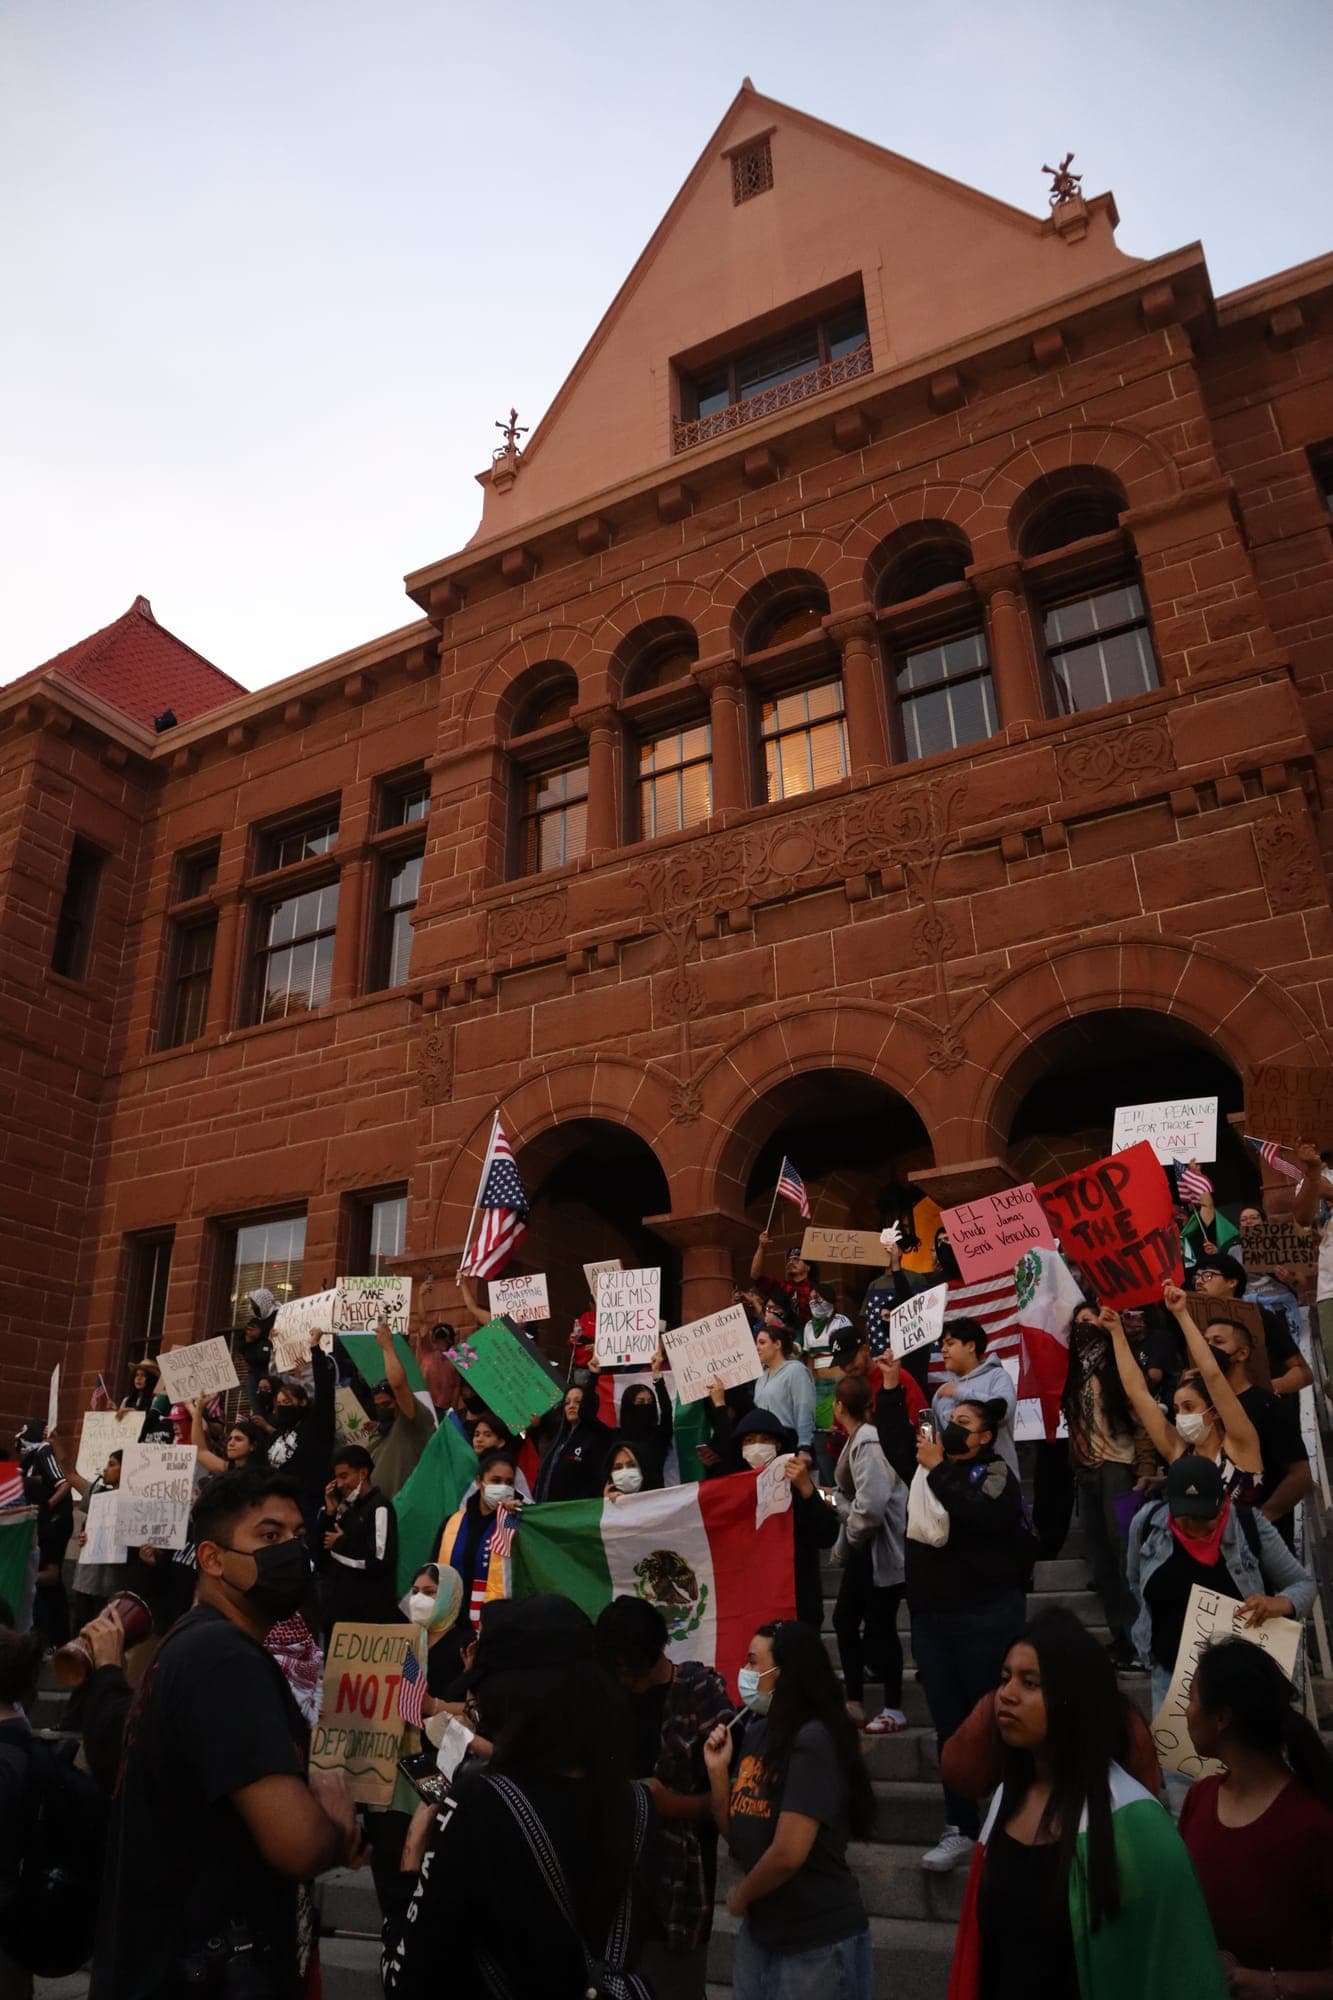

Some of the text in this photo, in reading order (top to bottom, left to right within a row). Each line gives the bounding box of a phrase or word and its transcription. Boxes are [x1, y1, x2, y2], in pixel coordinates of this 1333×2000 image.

[1151, 1103, 1217, 1119] PEAKING
[990, 1191, 1034, 1212] Pueblo
[1040, 1162, 1129, 1229] STOP
[811, 1231, 859, 1244] FUCK
[1072, 1210, 1139, 1251] THE
[827, 1246, 865, 1260] ICE
[1241, 1236, 1313, 1251] DEPORTING
[1243, 1250, 1314, 1268] FAMILIES!
[499, 1276, 532, 1293] STOP
[641, 1269, 660, 1287] LO
[359, 1288, 385, 1302] MAKE
[495, 1288, 543, 1303] KIDNAPPING
[505, 1299, 528, 1311] OUR
[601, 1286, 653, 1309] QUE MIS
[340, 1300, 381, 1322] AMERICA
[599, 1308, 657, 1335] PADRES
[714, 1309, 742, 1329] about
[891, 1296, 925, 1328] TRUMP
[596, 1333, 658, 1359] CALLARON
[706, 1352, 745, 1374] about
[142, 1478, 188, 1502] SEEKING
[335, 1672, 406, 1722] NOT
[312, 1726, 401, 1764] DEPORTATION
